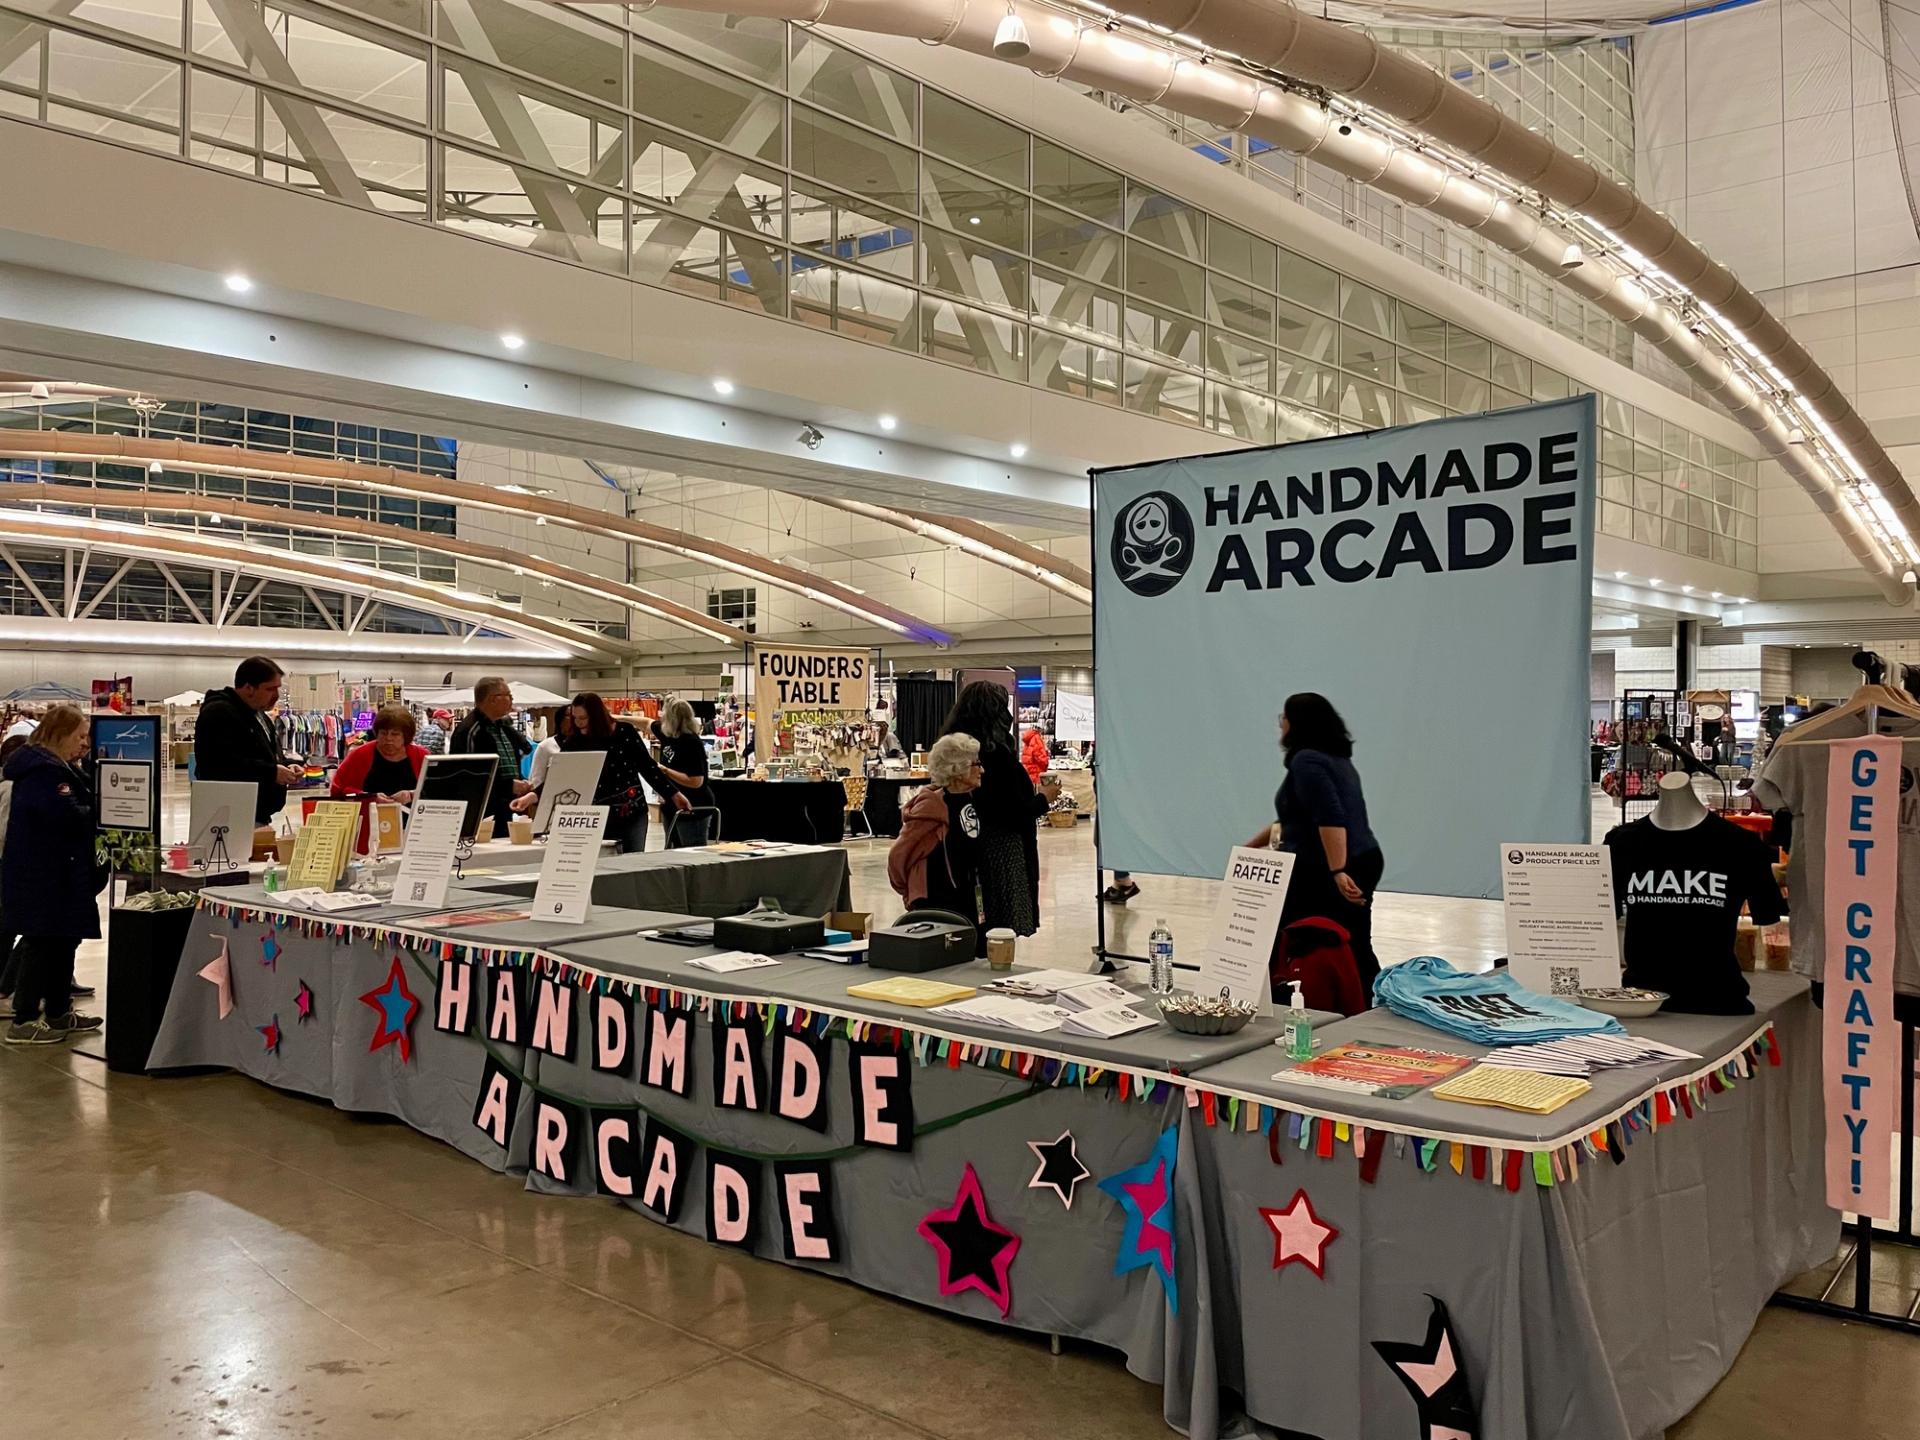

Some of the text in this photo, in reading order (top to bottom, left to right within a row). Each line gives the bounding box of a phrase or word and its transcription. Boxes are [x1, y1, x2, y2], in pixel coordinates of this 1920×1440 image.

[1203, 431, 1579, 527] HANDMADE
[1204, 491, 1578, 593] ARCADE
[759, 652, 864, 679] FOUNDERS
[777, 680, 841, 704] TABLE
[558, 817, 600, 829] RAFFLE
[1847, 748, 1878, 877] GET
[1232, 863, 1283, 886] RAFFLE
[1237, 855, 1284, 868] Handmade Arcade
[1627, 869, 1729, 899] MAKE
[1637, 896, 1725, 908] HANDMADE ARCADE
[438, 960, 898, 1145] HANDMADE
[1841, 902, 1875, 1194] CRAFTY!
[477, 1071, 831, 1259] ARCADE
